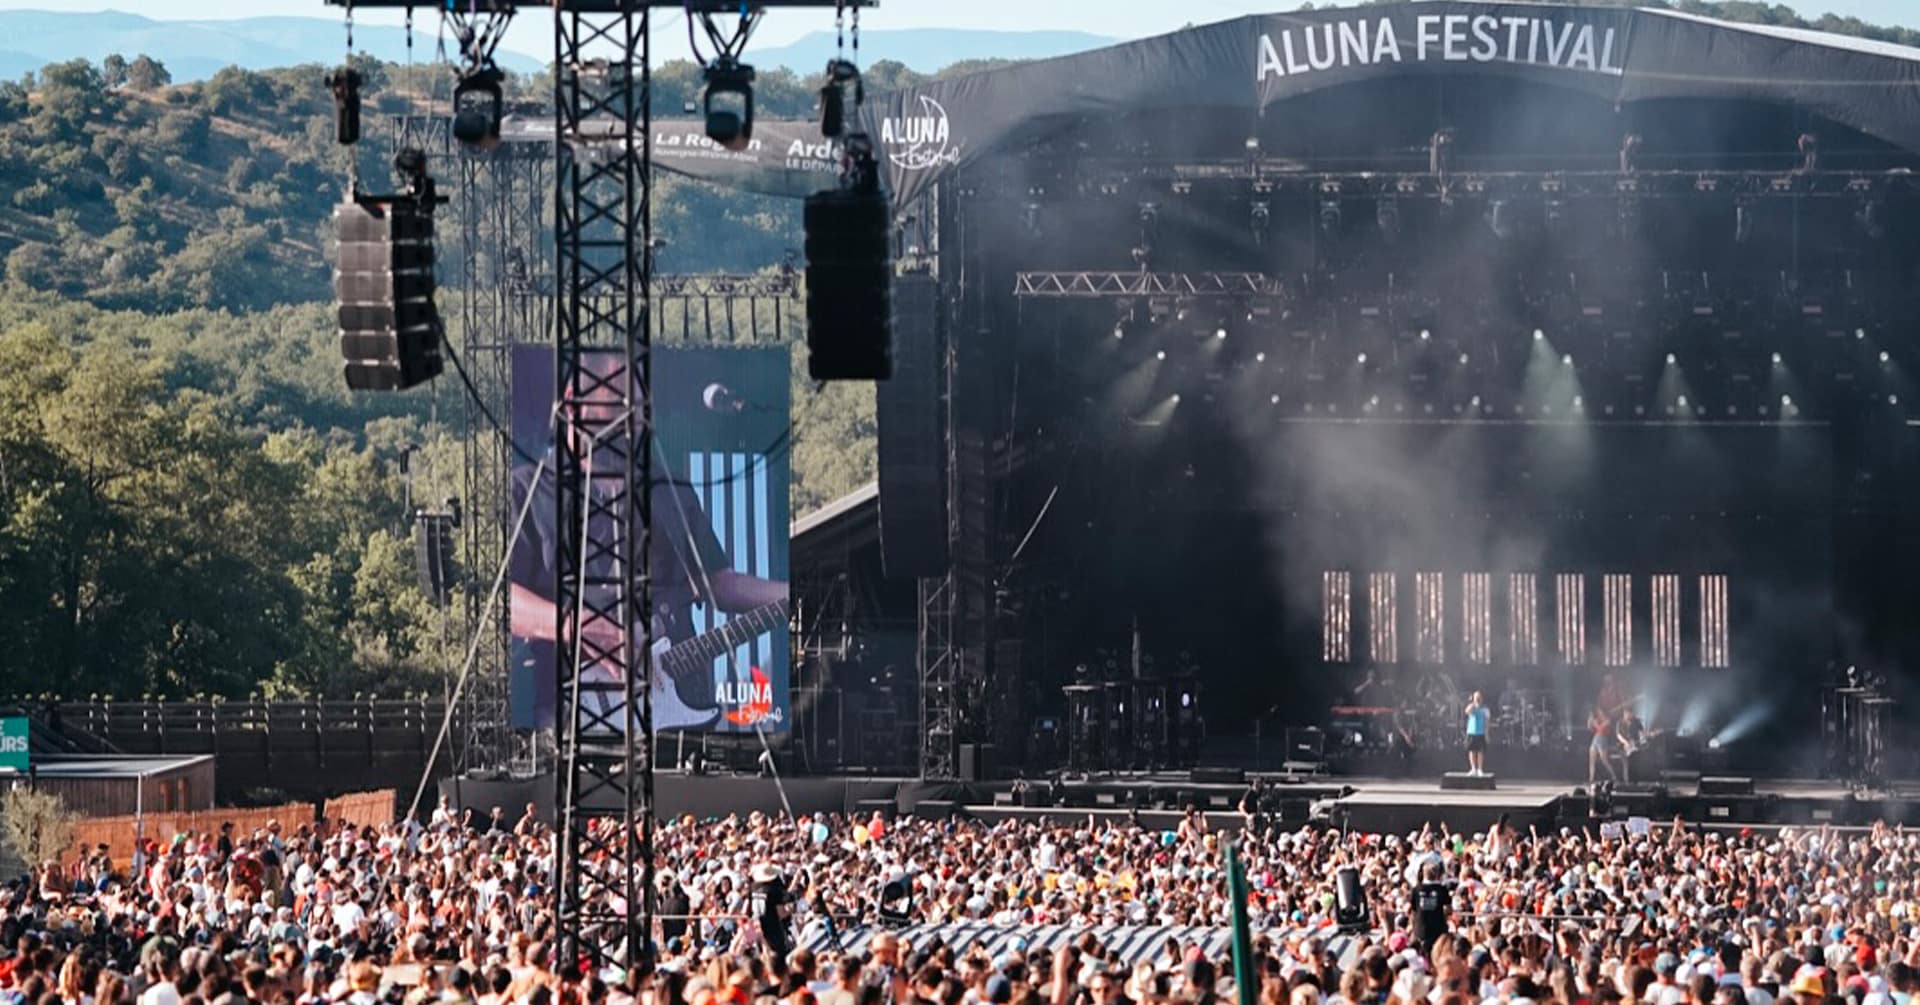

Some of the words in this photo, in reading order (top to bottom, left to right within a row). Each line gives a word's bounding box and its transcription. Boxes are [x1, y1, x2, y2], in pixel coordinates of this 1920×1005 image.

[1257, 17, 1401, 81] ALUNA
[1417, 15, 1623, 76] FESTIVAL
[655, 132, 680, 145] La
[881, 117, 949, 144] ALUNA
[715, 682, 773, 704] ALUNA
